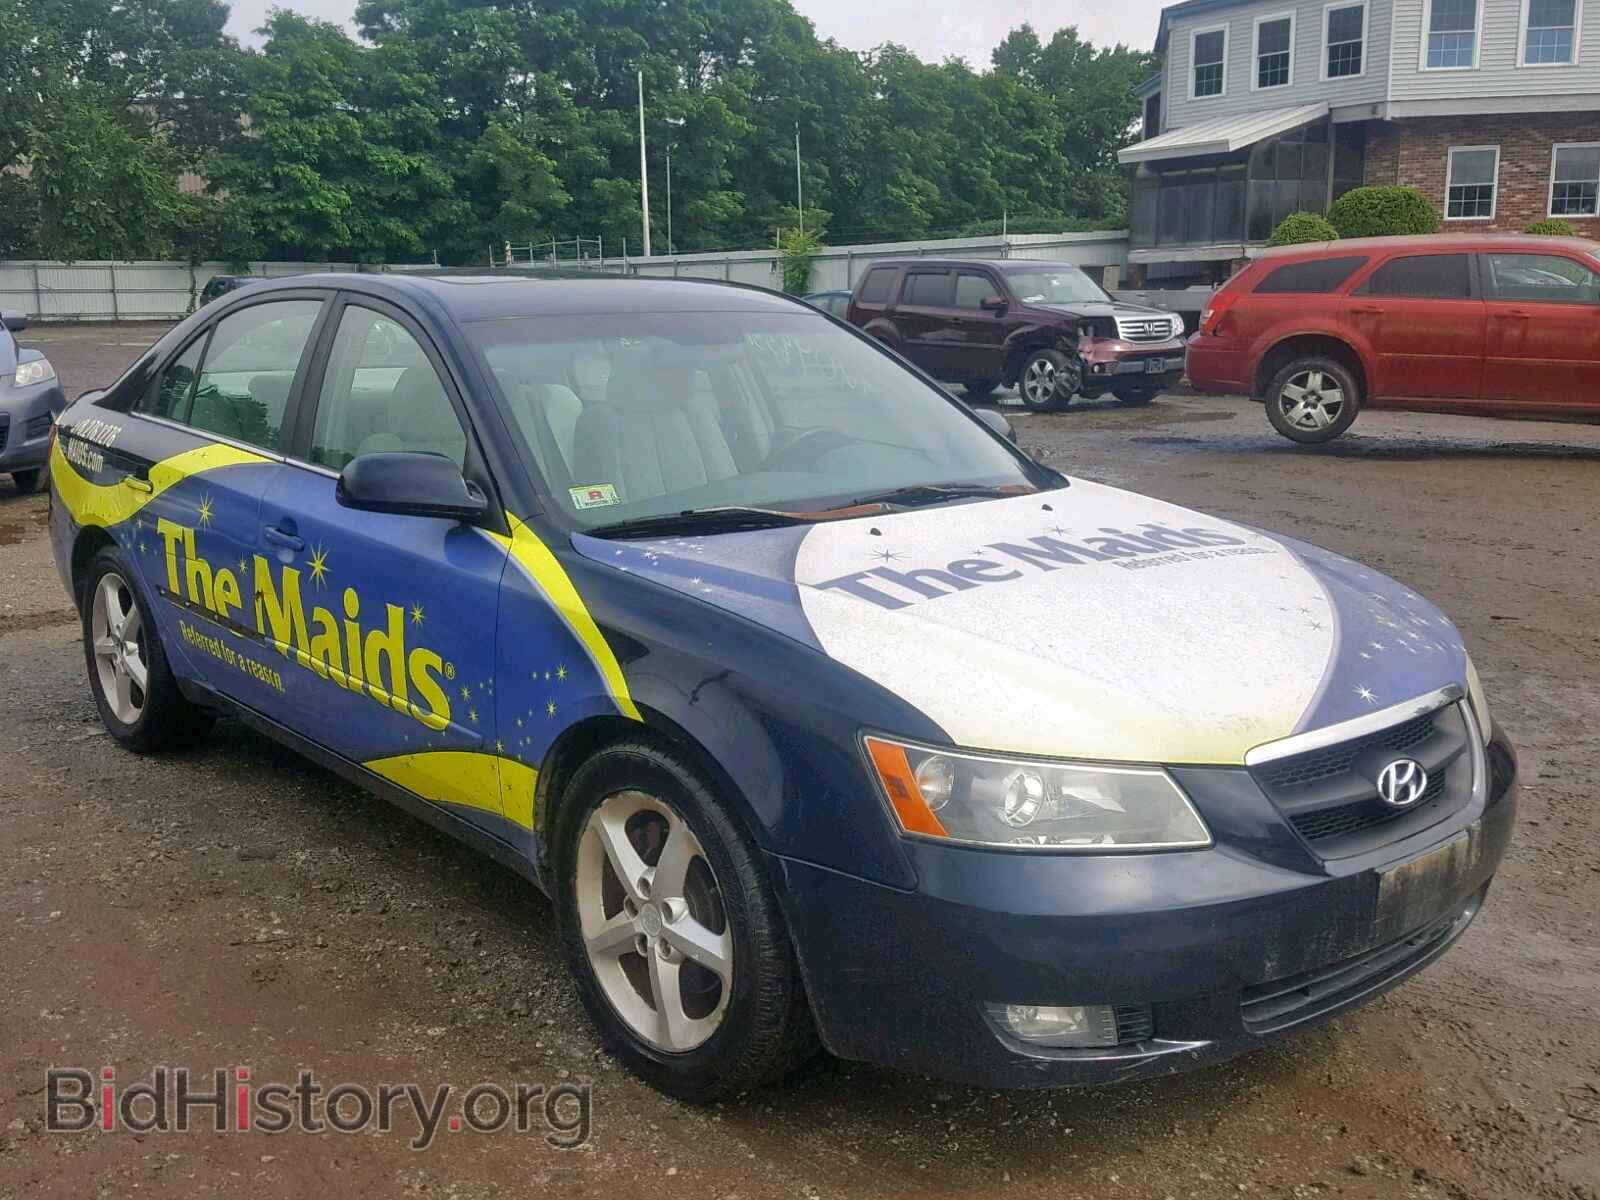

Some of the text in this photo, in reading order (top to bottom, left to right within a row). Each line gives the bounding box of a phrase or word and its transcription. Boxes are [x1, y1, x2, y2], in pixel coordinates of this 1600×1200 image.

[156, 517, 243, 620] The
[815, 521, 1247, 610] The Maids
